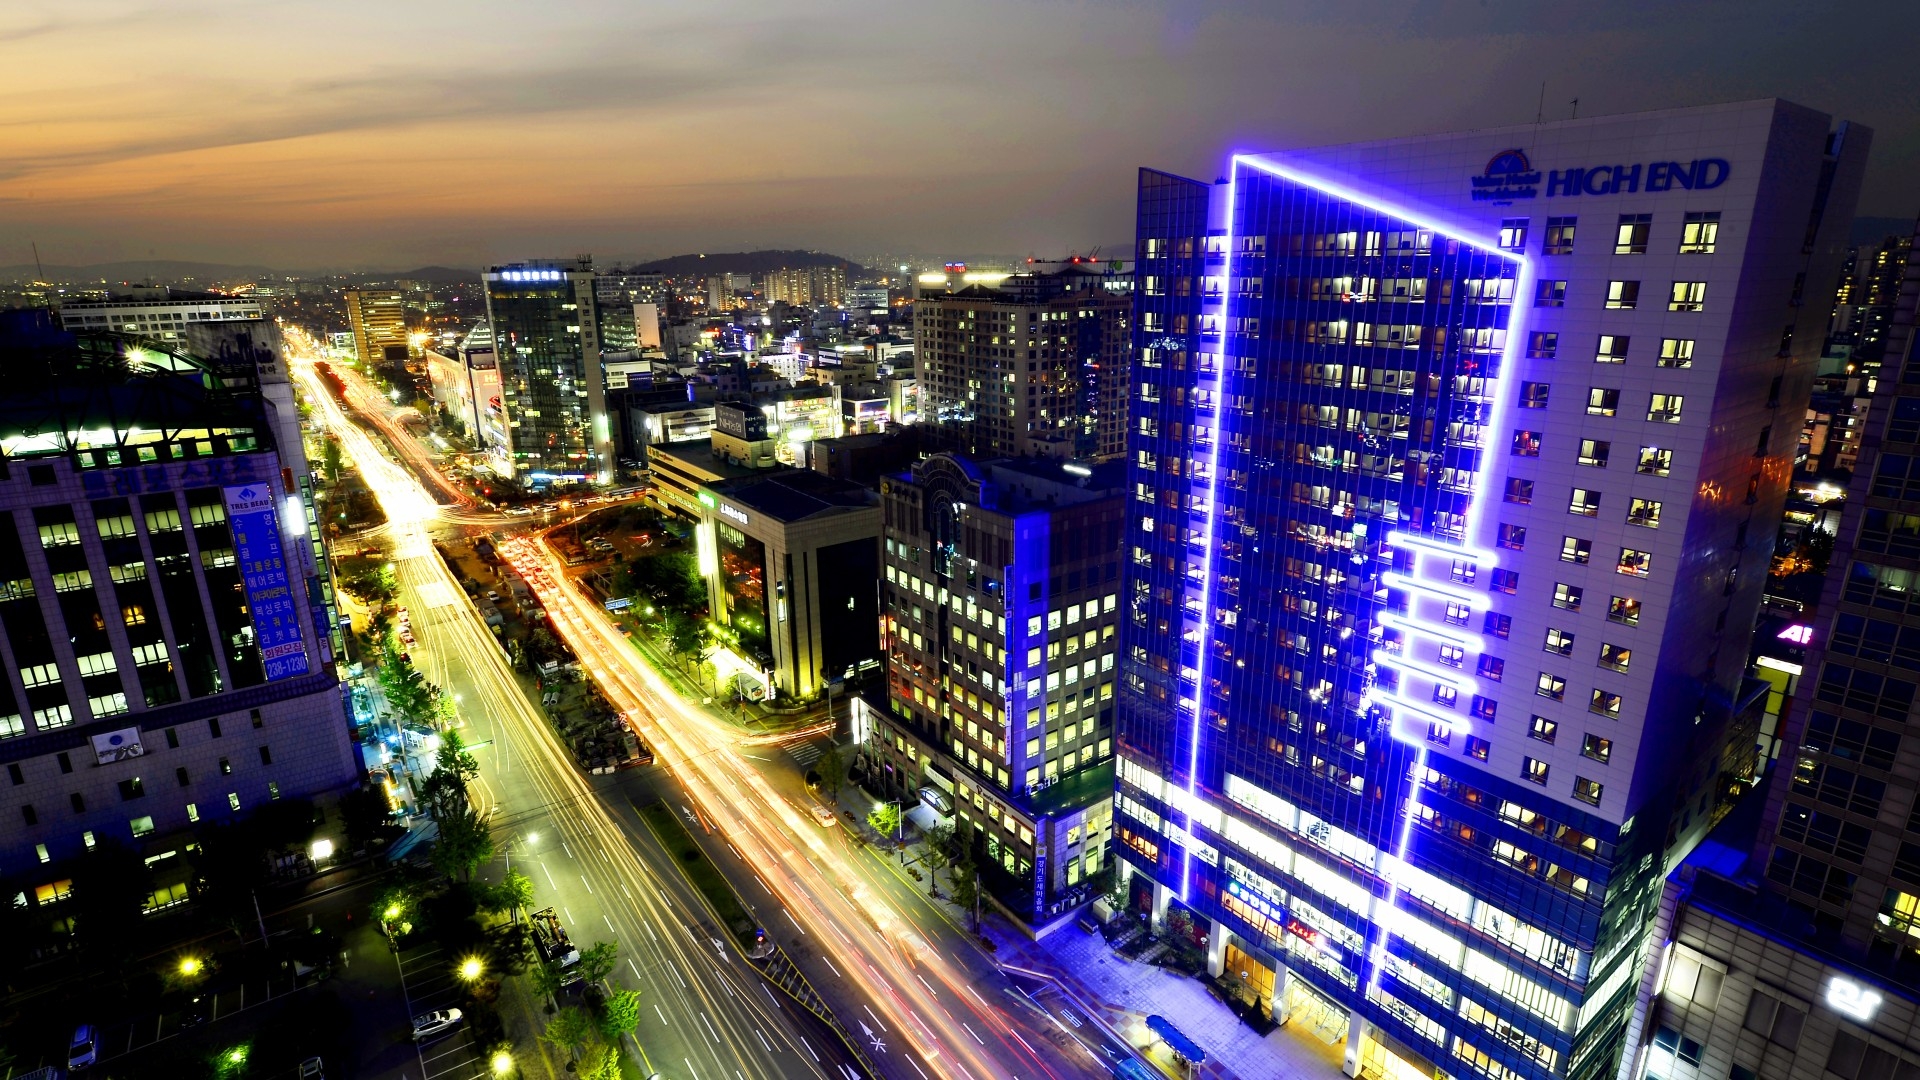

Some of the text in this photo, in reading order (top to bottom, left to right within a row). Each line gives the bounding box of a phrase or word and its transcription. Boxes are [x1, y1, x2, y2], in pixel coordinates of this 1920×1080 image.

[1546, 158, 1730, 198] HIGH END
[181, 455, 257, 488] 스포츠
[230, 499, 269, 511] TRES BEAU
[247, 572, 286, 588] 에어로빅
[265, 641, 303, 658] 회원모집
[267, 655, 306, 678] 238-1230
[1035, 859, 1046, 913] 경기도새마을회
